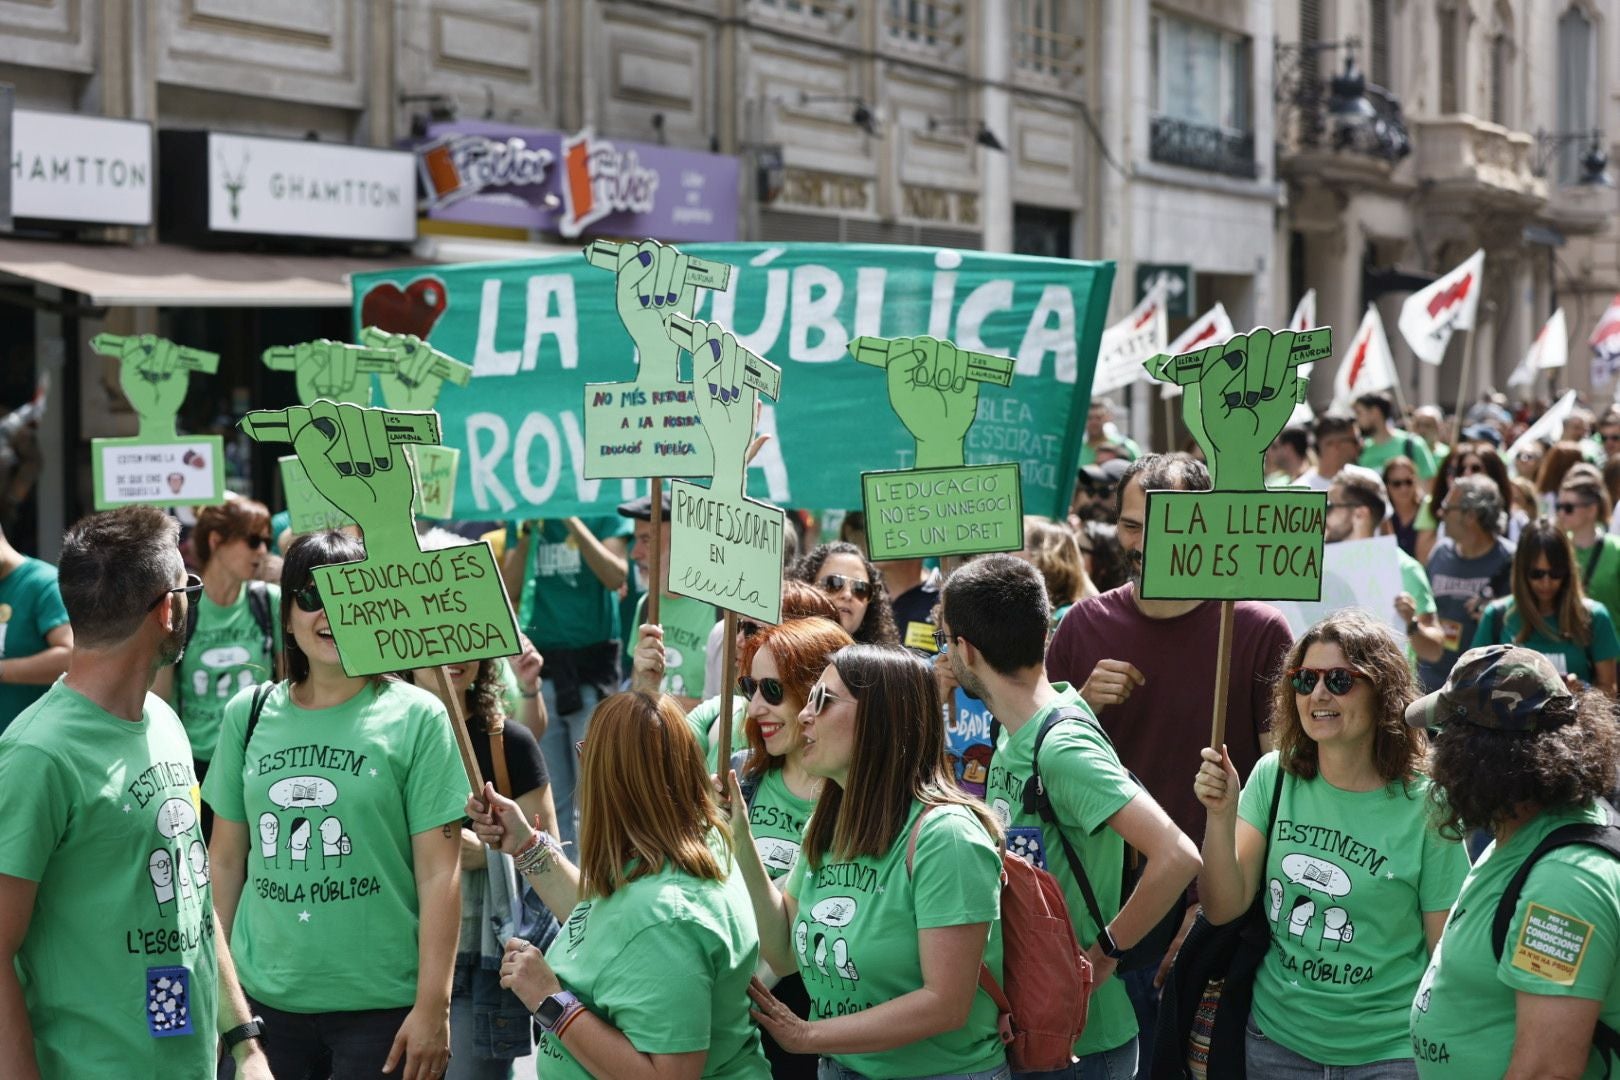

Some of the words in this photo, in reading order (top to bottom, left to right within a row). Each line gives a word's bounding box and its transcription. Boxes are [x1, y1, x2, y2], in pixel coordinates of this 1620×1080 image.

[268, 172, 400, 209] GHAMTTON
[472, 274, 580, 379] LA
[593, 391, 613, 407] NO
[620, 387, 647, 408] MÉS
[620, 417, 630, 429] A
[638, 415, 654, 429] LA
[875, 474, 998, 503] L'EDUCACIÓ
[677, 489, 780, 555] PROFESSORAT
[880, 506, 904, 525] NO
[937, 501, 958, 518] UN
[958, 494, 1014, 516] NEGOCI
[1164, 502, 1207, 535] LA
[1227, 503, 1326, 537] LLENGUA
[885, 529, 910, 551] ÉS
[920, 525, 948, 546] UN
[956, 521, 1004, 541] DRET
[709, 543, 725, 566] EN
[1170, 543, 1202, 578] NO
[1212, 544, 1239, 577] ES
[1256, 544, 1319, 579] TOCA
[326, 554, 443, 596] L'EDUCACIÓ
[450, 551, 485, 581] ÉS
[679, 566, 768, 609] lluita
[340, 598, 411, 626] L'ARMA
[421, 587, 467, 616] MÉS
[374, 622, 508, 660] PODEROSA
[257, 744, 367, 777] ESTIMEM
[1277, 820, 1388, 877] ESTIMEM
[126, 922, 200, 955] L'ESCOLA
[1526, 925, 1581, 953] CONDICIONS
[1528, 915, 1563, 935] MILLORA
[1525, 937, 1575, 963] LABORALS
